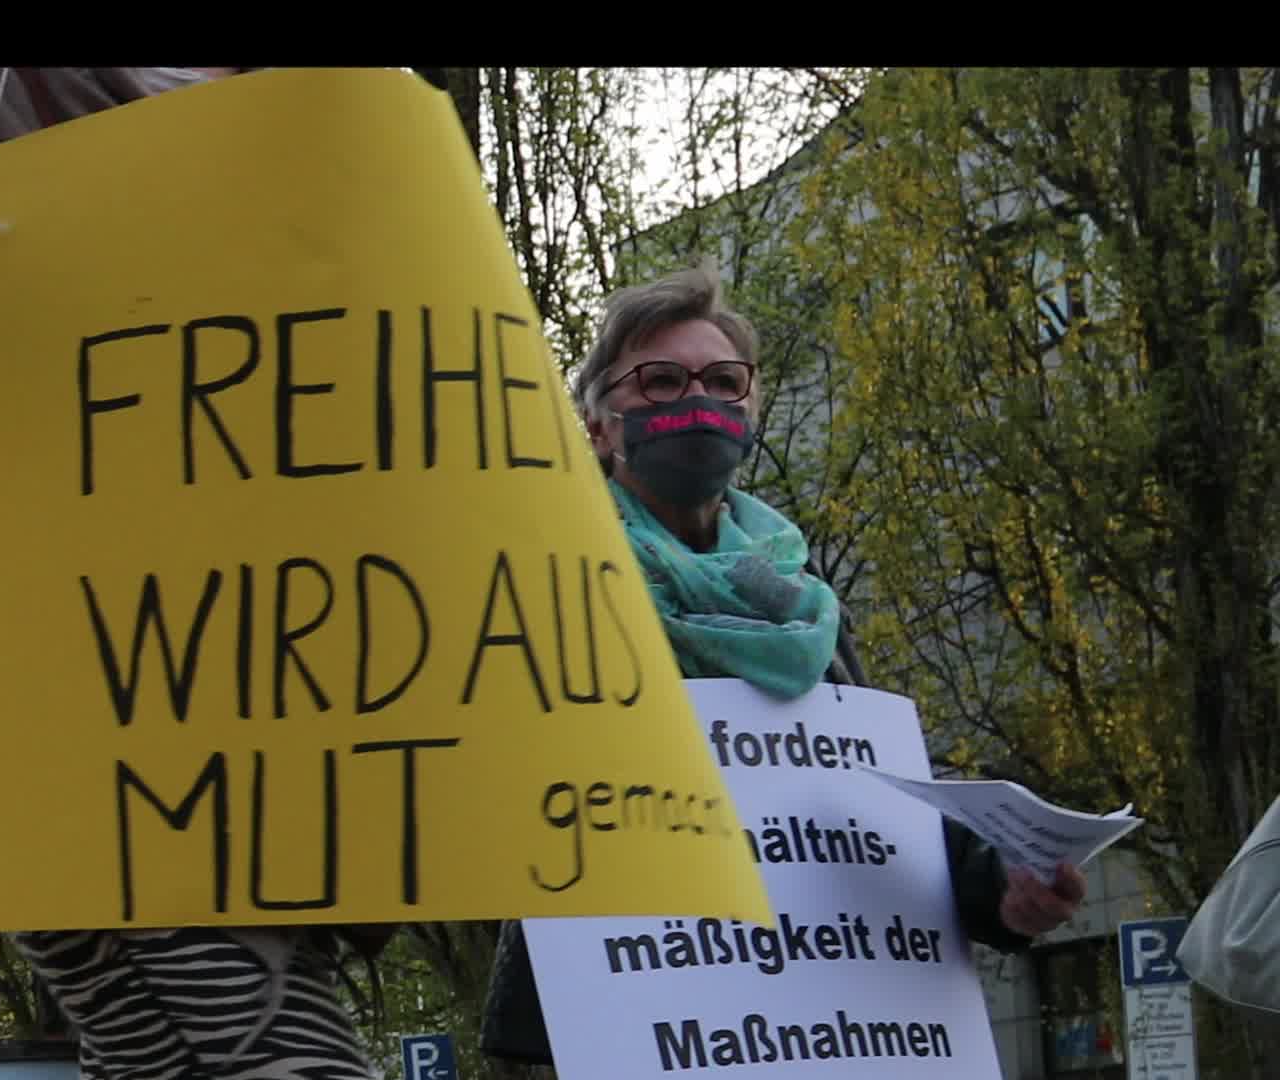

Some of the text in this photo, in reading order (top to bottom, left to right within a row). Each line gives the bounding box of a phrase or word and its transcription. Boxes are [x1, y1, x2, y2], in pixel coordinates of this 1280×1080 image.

[80, 549, 642, 727] WIRD AUS
[709, 719, 878, 769] fordern
[116, 737, 461, 921] MUT
[603, 912, 943, 976] mäßigkeit der
[1132, 929, 1168, 980] P
[652, 1010, 953, 1072] Maßnahmen
